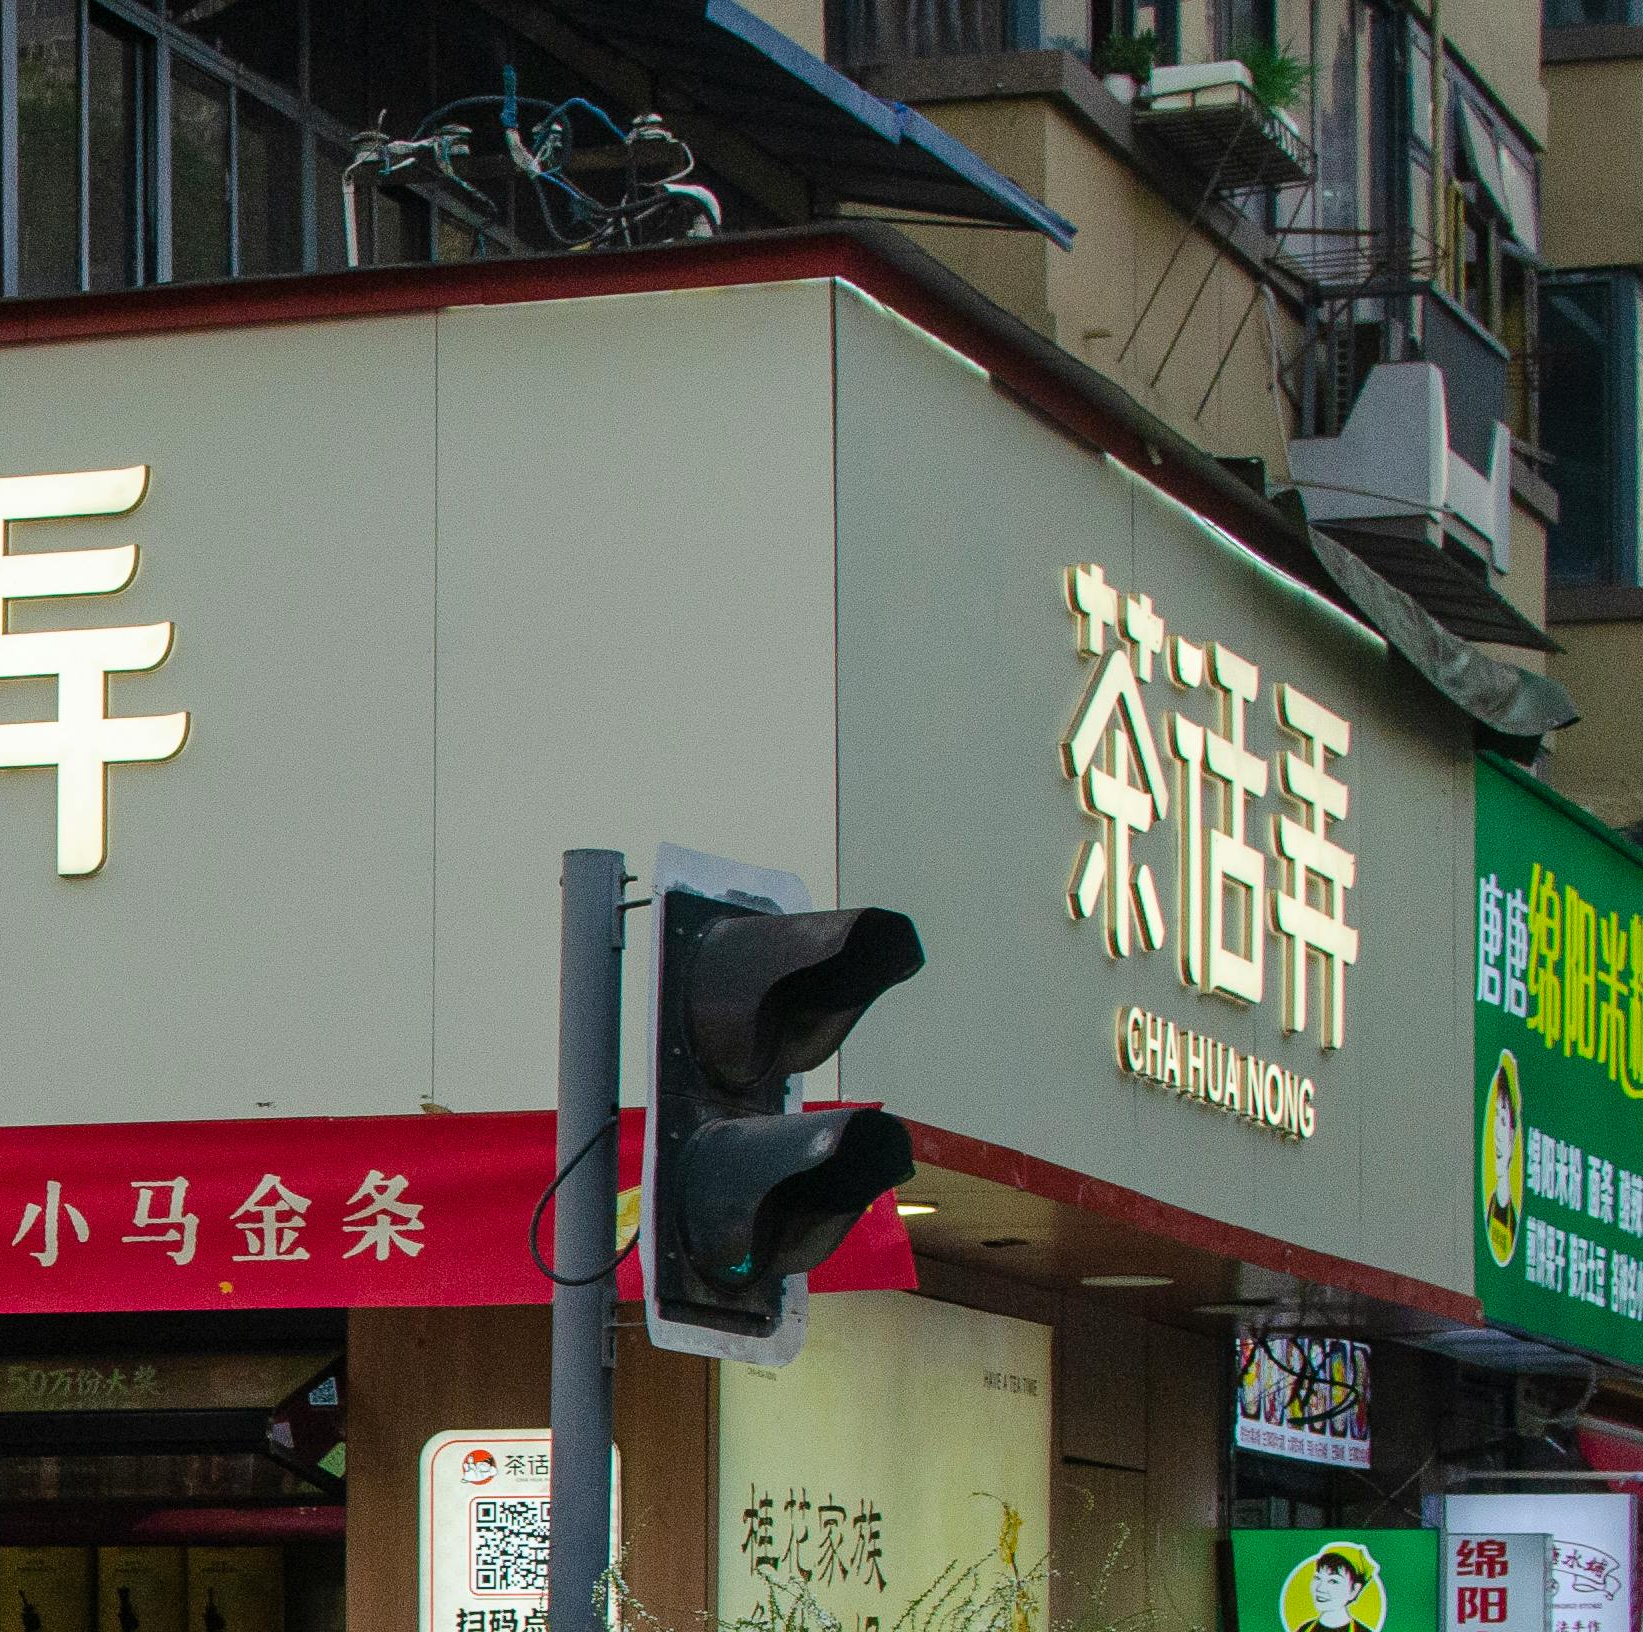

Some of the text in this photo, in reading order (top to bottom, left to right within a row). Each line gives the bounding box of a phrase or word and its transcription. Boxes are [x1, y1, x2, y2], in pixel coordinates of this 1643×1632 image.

[1060, 561, 1359, 1050] 茶话弄
[1477, 873, 1528, 1018] 唐唐
[1123, 1006, 1316, 1140] CHA HUA NONG
[741, 1482, 886, 1594] 桂花家族
